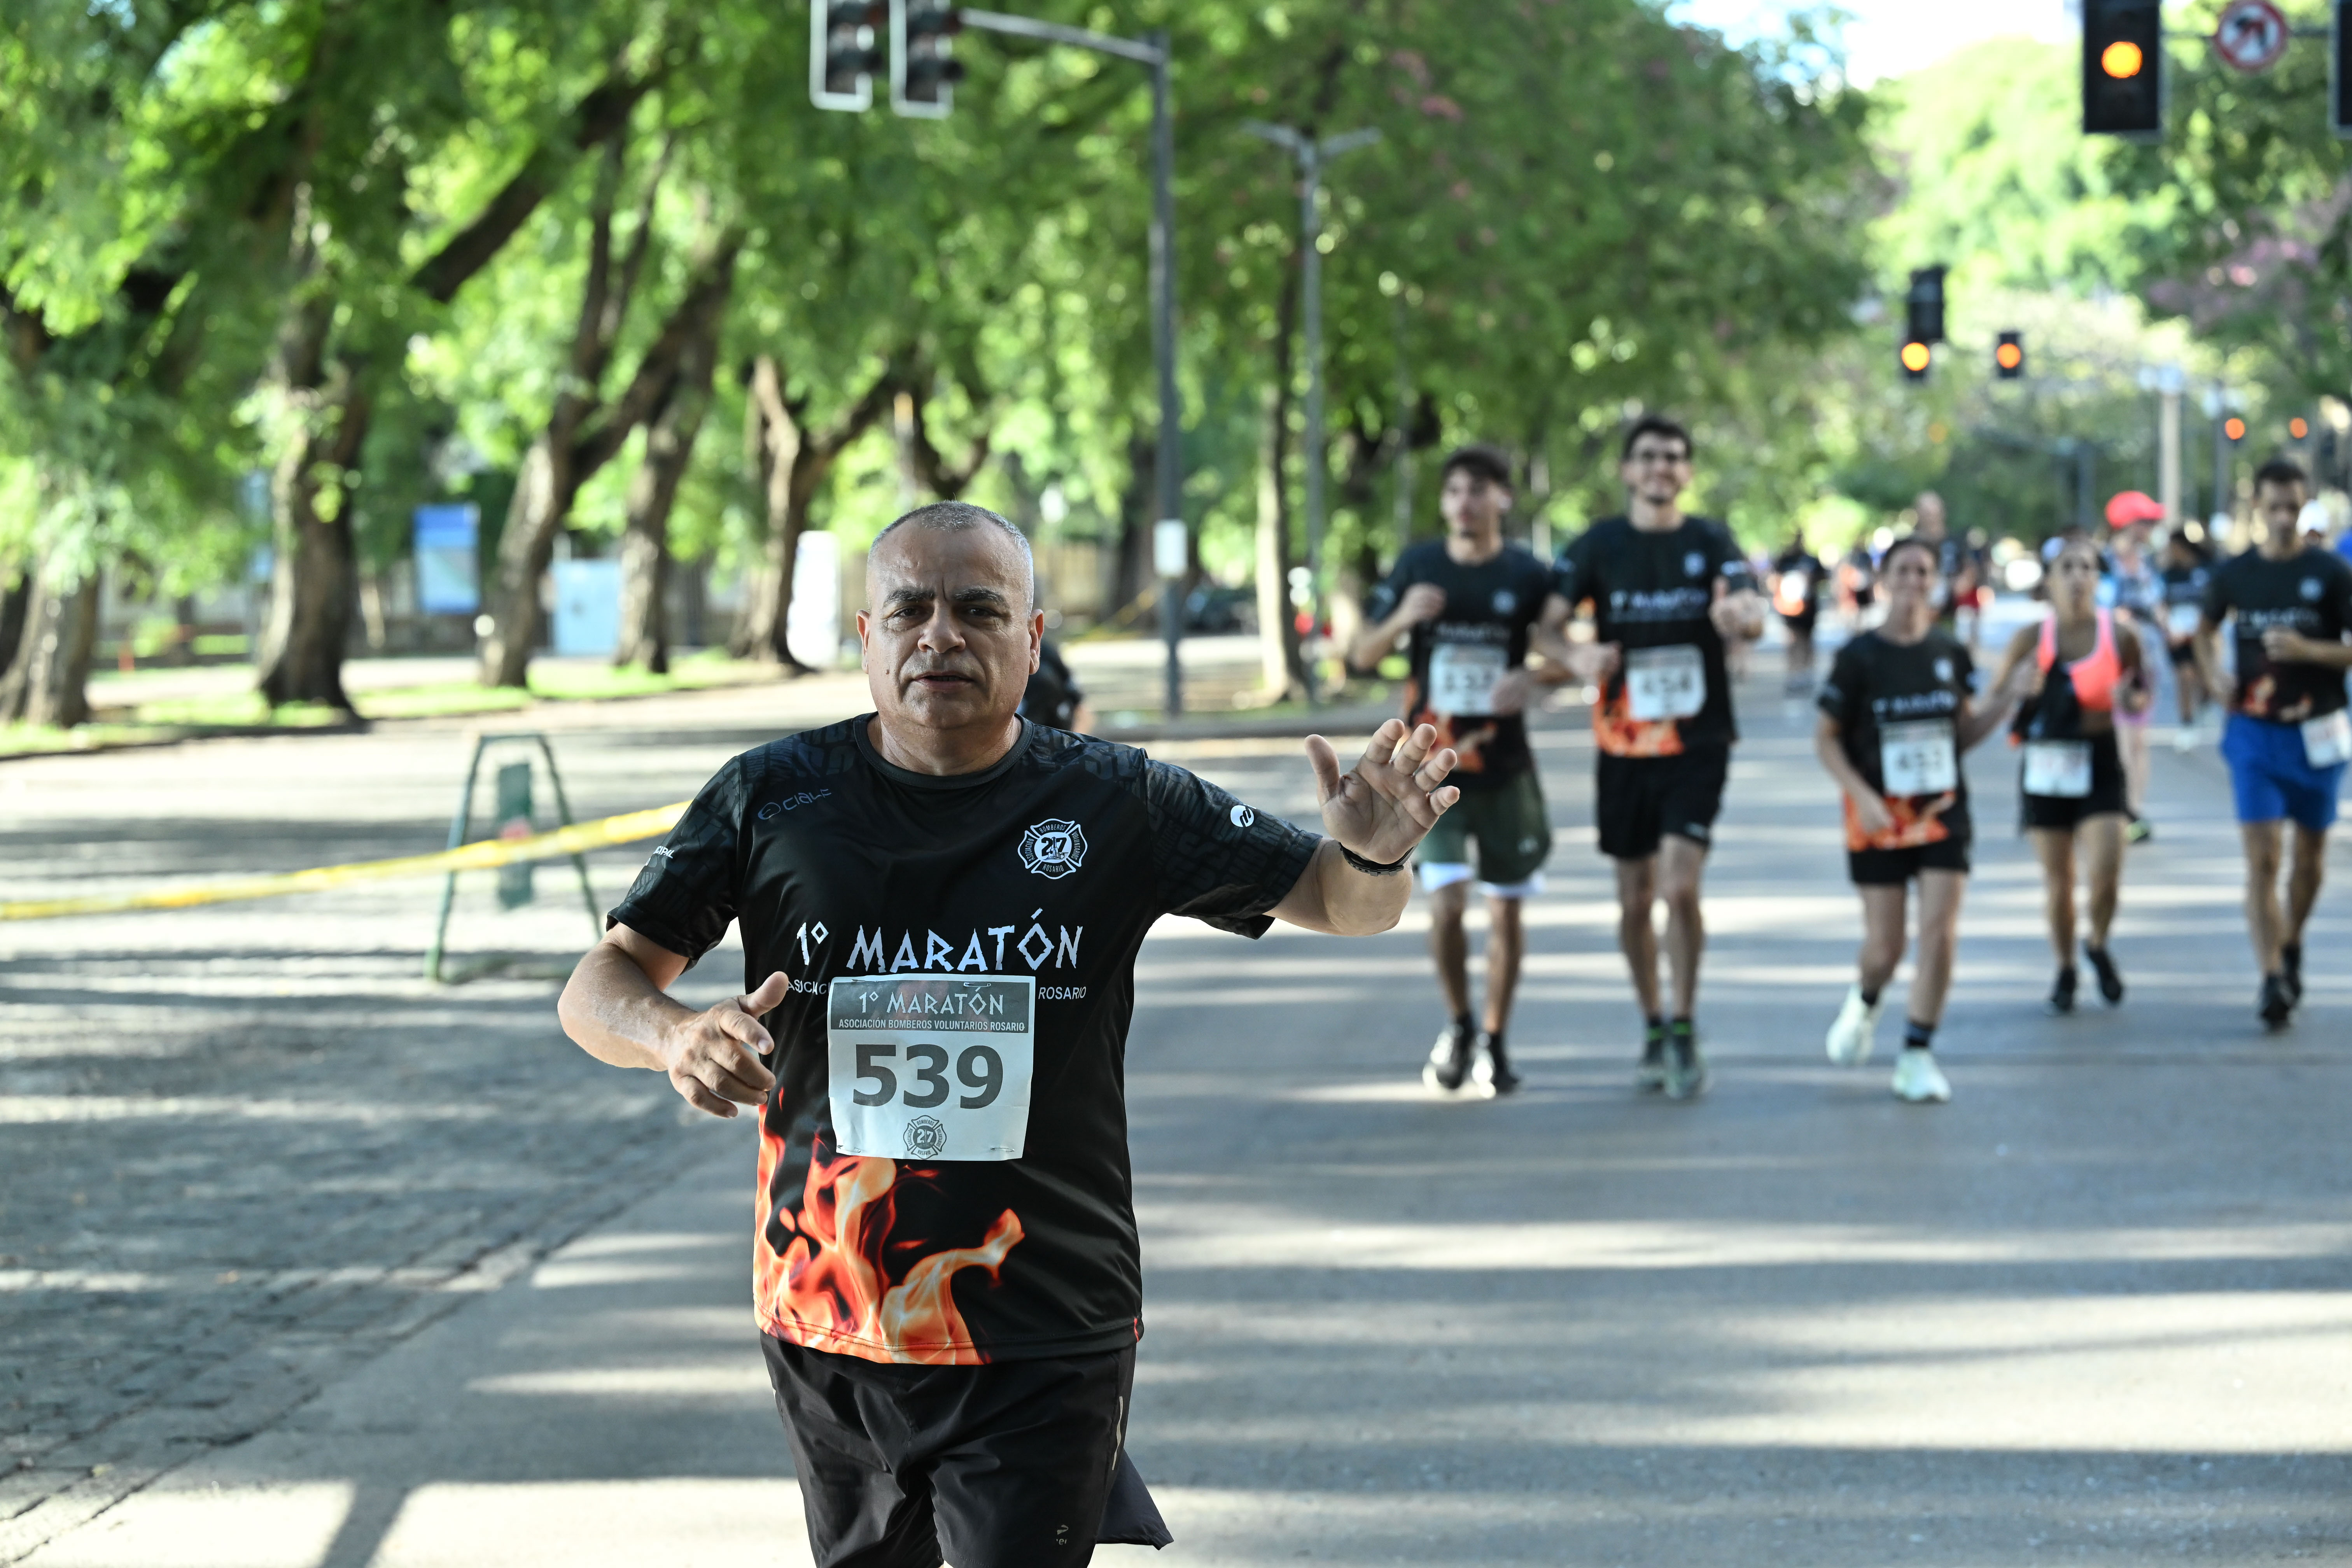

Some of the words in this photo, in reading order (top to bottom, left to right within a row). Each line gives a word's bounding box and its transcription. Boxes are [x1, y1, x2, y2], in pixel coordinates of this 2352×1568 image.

[1039, 824, 1066, 833] BOMBEROS
[1025, 837, 1035, 861] ASOCIACIÓN
[1041, 837, 1067, 858] 27
[1071, 831, 1081, 860] VOLUNTARIOS
[1042, 864, 1064, 872] ROSARIO
[846, 907, 1083, 973] MARATÓN
[886, 987, 1003, 1015] MARATÓN
[1038, 986, 1087, 999] ROSARIO
[838, 1017, 886, 1029] ASOCIACIÓN
[888, 1019, 932, 1029] BOMBEROS
[934, 1020, 988, 1031] VOLUNTARIOS
[990, 1021, 1025, 1031] ROSARIO
[853, 1043, 1004, 1110] 539
[917, 1129, 934, 1143] 27
